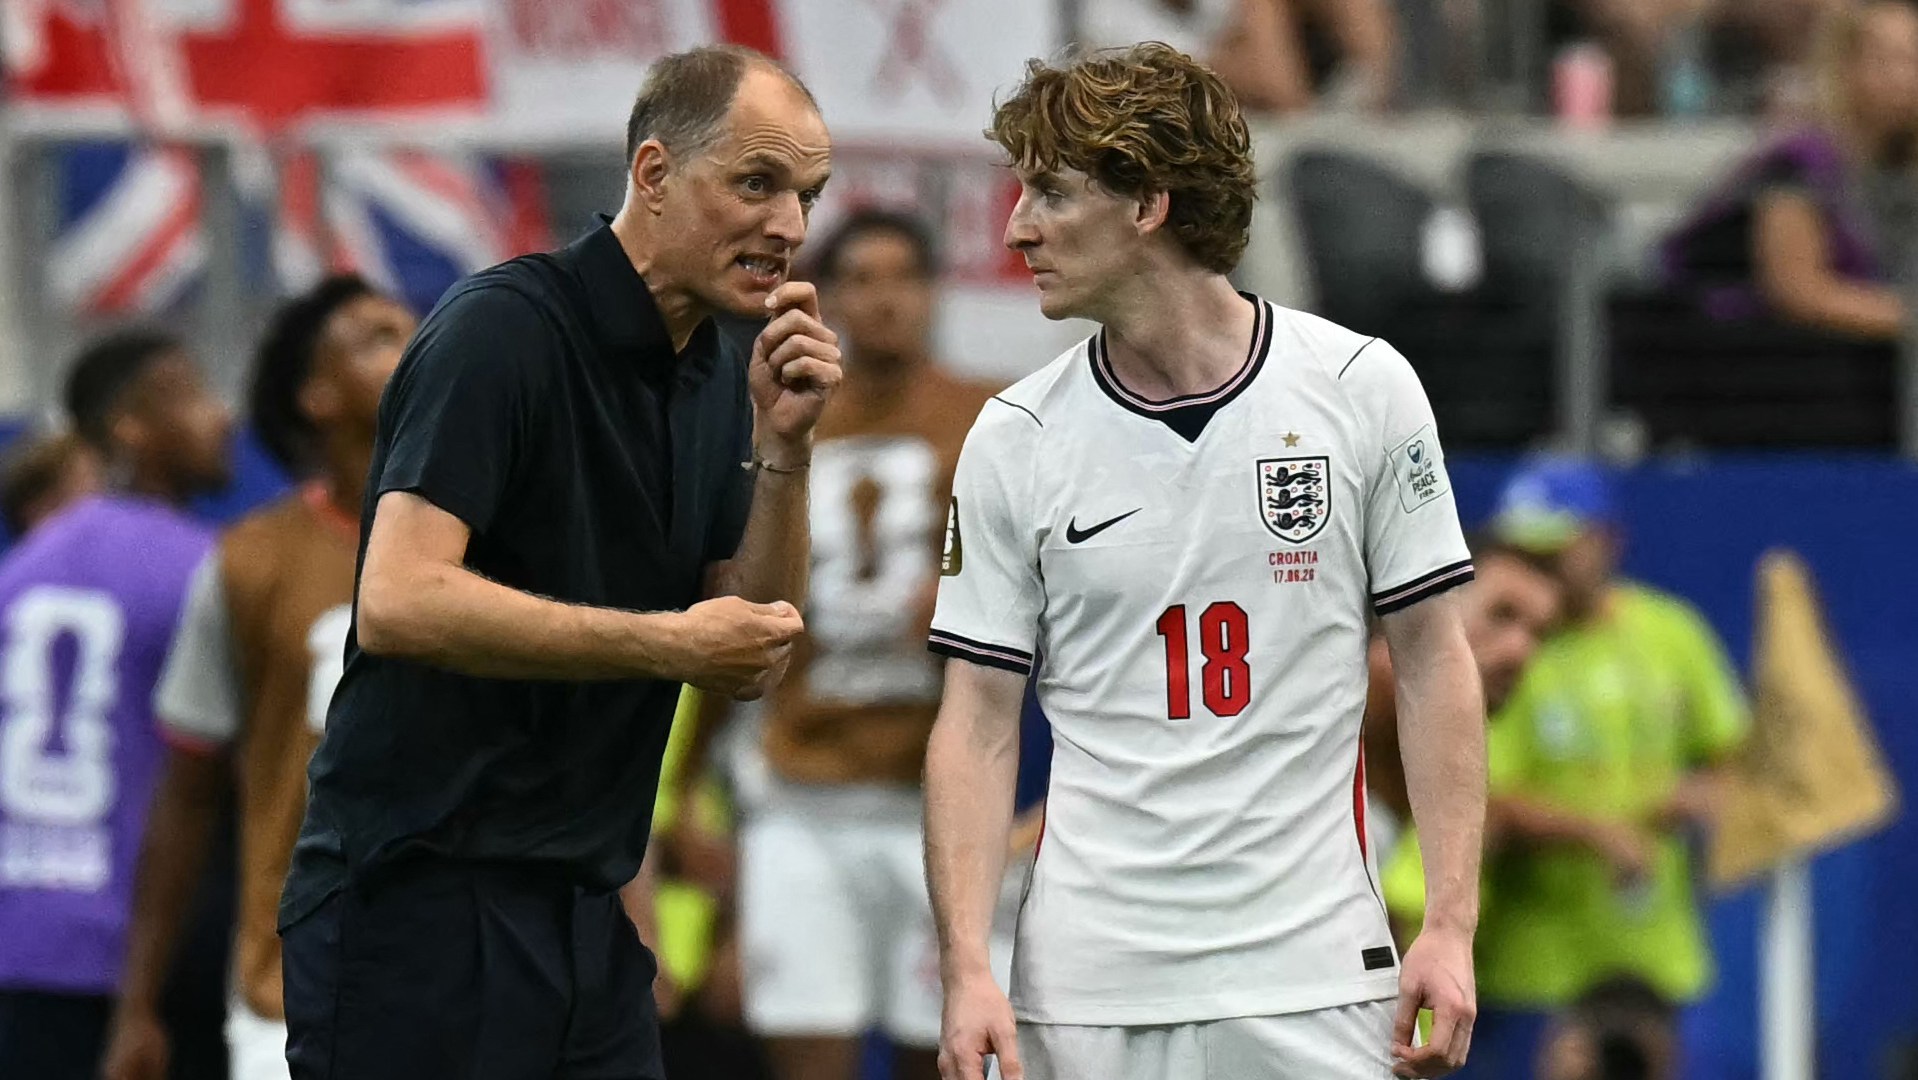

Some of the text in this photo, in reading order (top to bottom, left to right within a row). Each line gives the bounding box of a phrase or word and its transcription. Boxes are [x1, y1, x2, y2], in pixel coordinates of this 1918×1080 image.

[1411, 470, 1438, 495] PEACE
[1268, 550, 1319, 566] CROATIA
[1273, 568, 1315, 584] 17.06.26
[1156, 601, 1251, 720] 18
